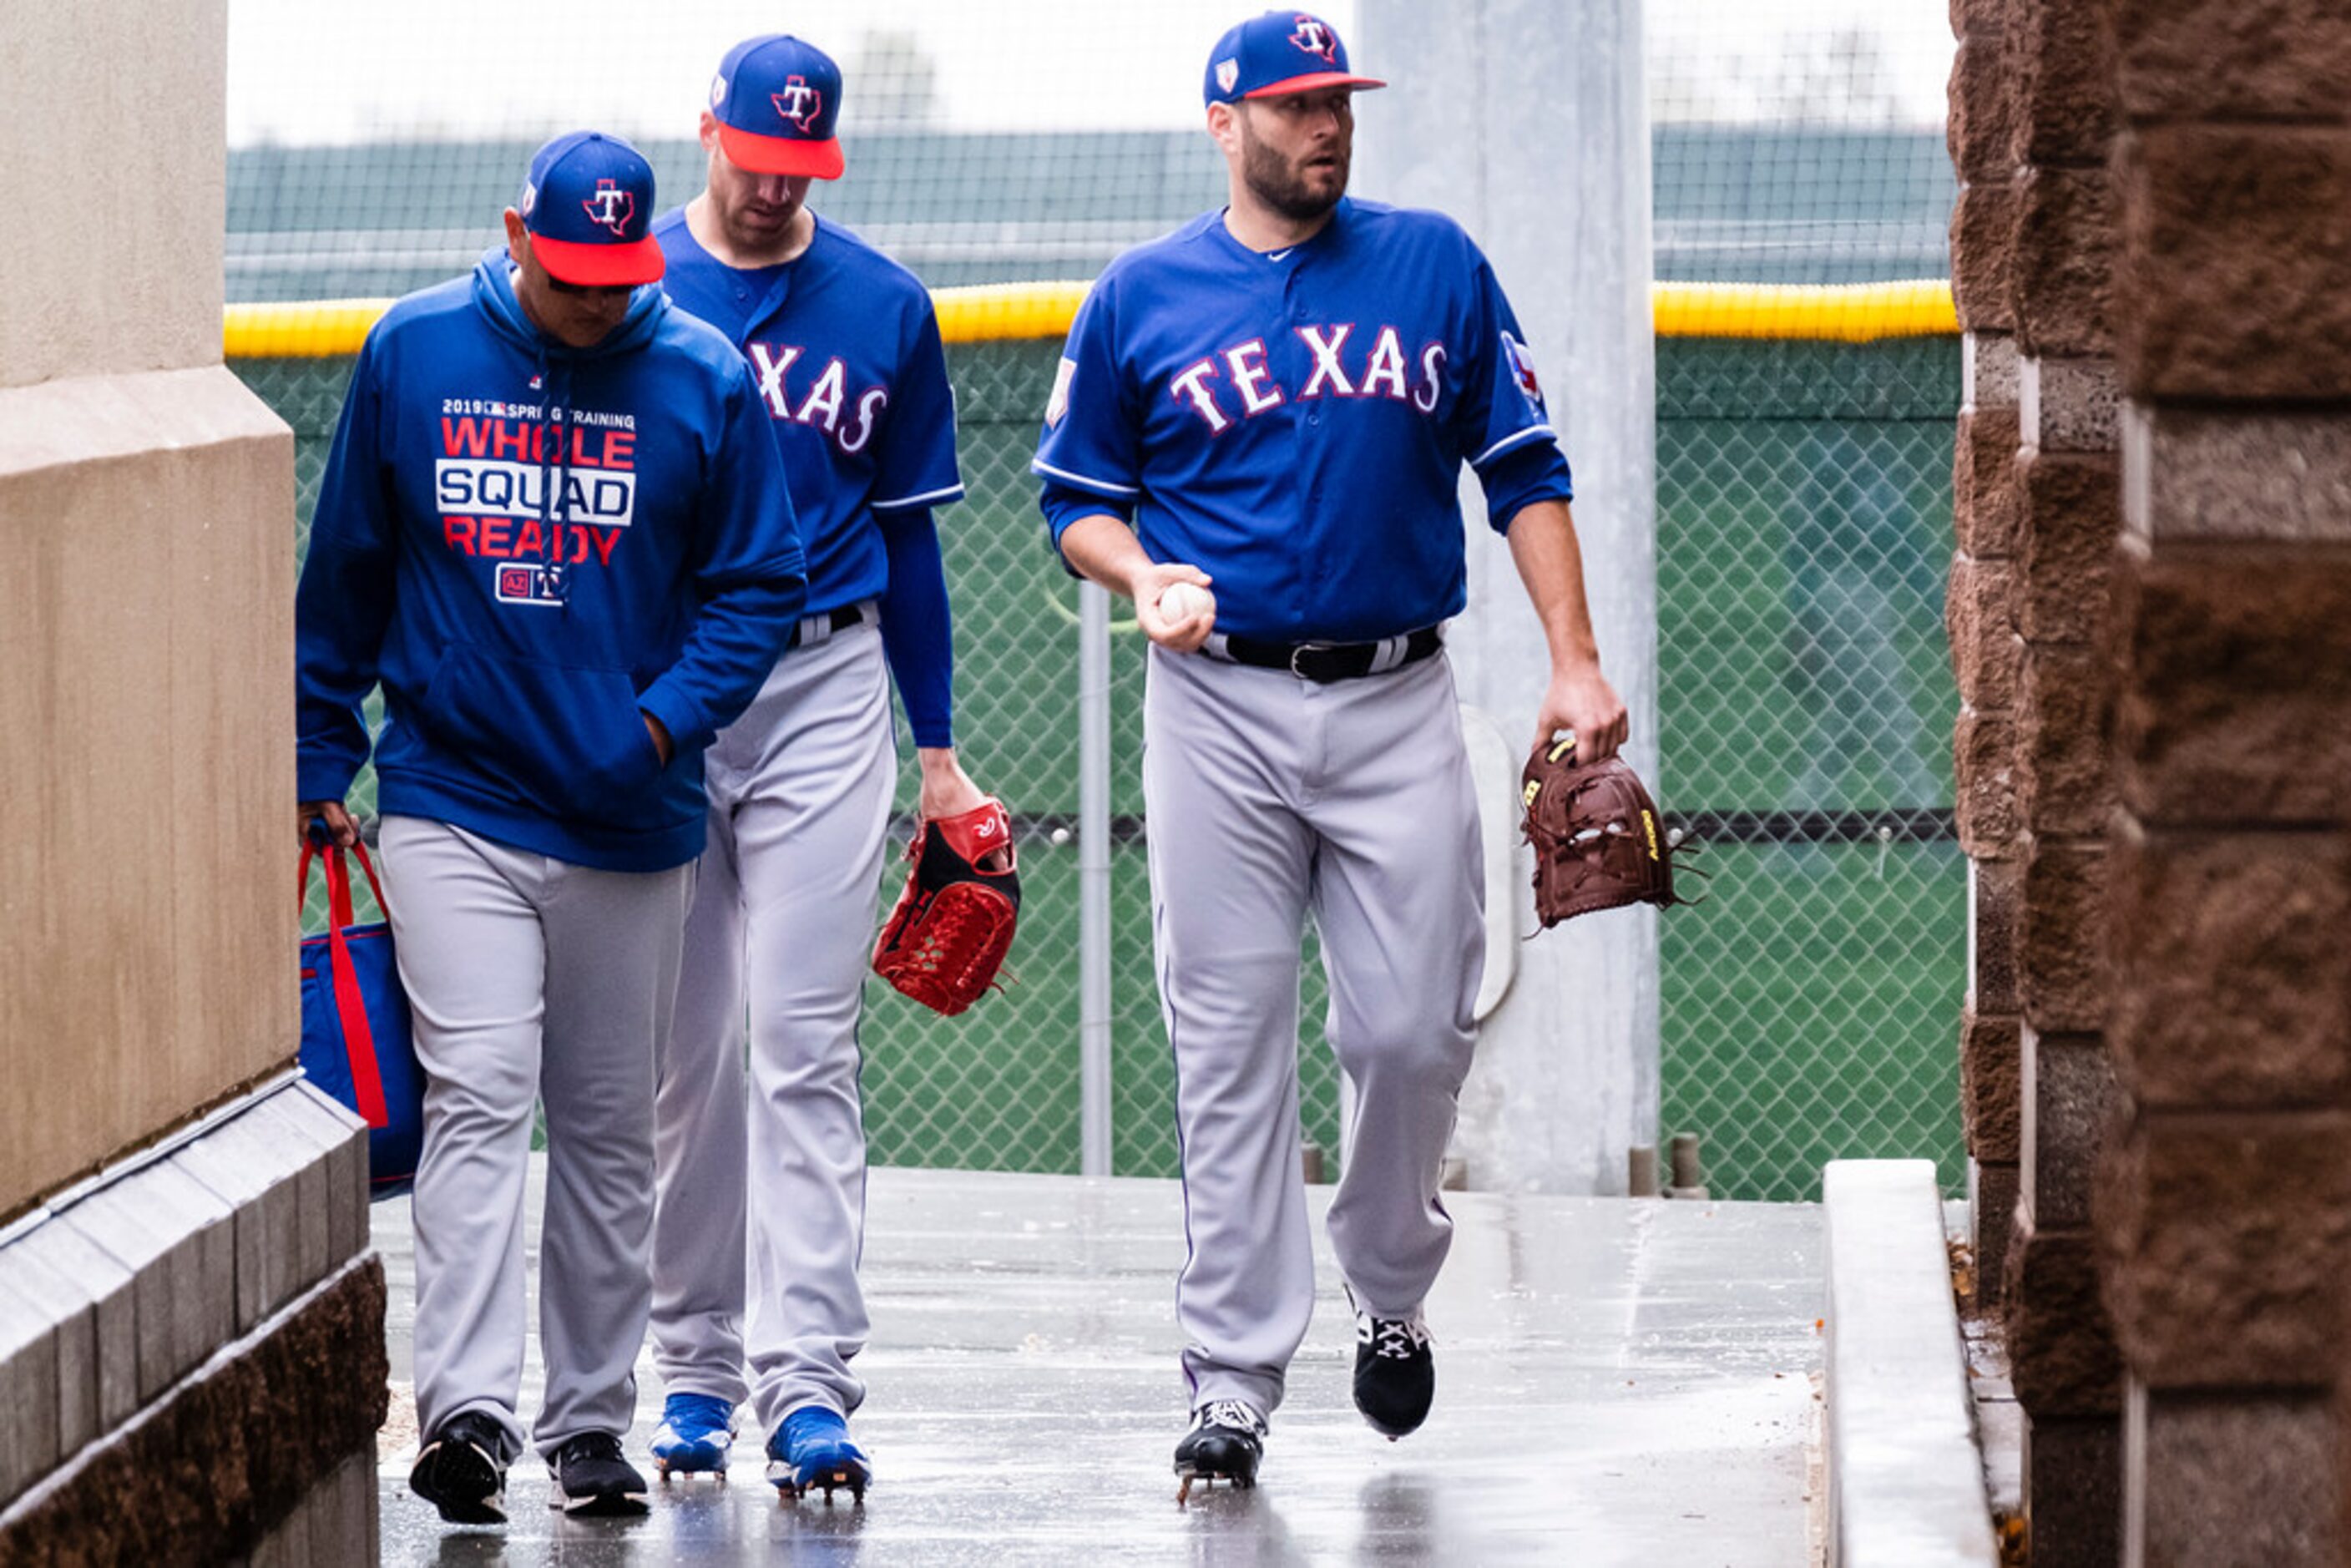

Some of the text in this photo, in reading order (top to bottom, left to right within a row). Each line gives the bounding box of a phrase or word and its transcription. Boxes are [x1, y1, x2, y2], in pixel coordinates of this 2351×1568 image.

[784, 85, 811, 118] T
[595, 190, 624, 223] T
[748, 341, 888, 456] XAS
[1170, 323, 1449, 438] TEXAS
[442, 399, 635, 432] 2019 SPRIG RAINING
[441, 417, 636, 469] WHOLE
[440, 468, 630, 518] SQUAD
[442, 515, 623, 567] READY
